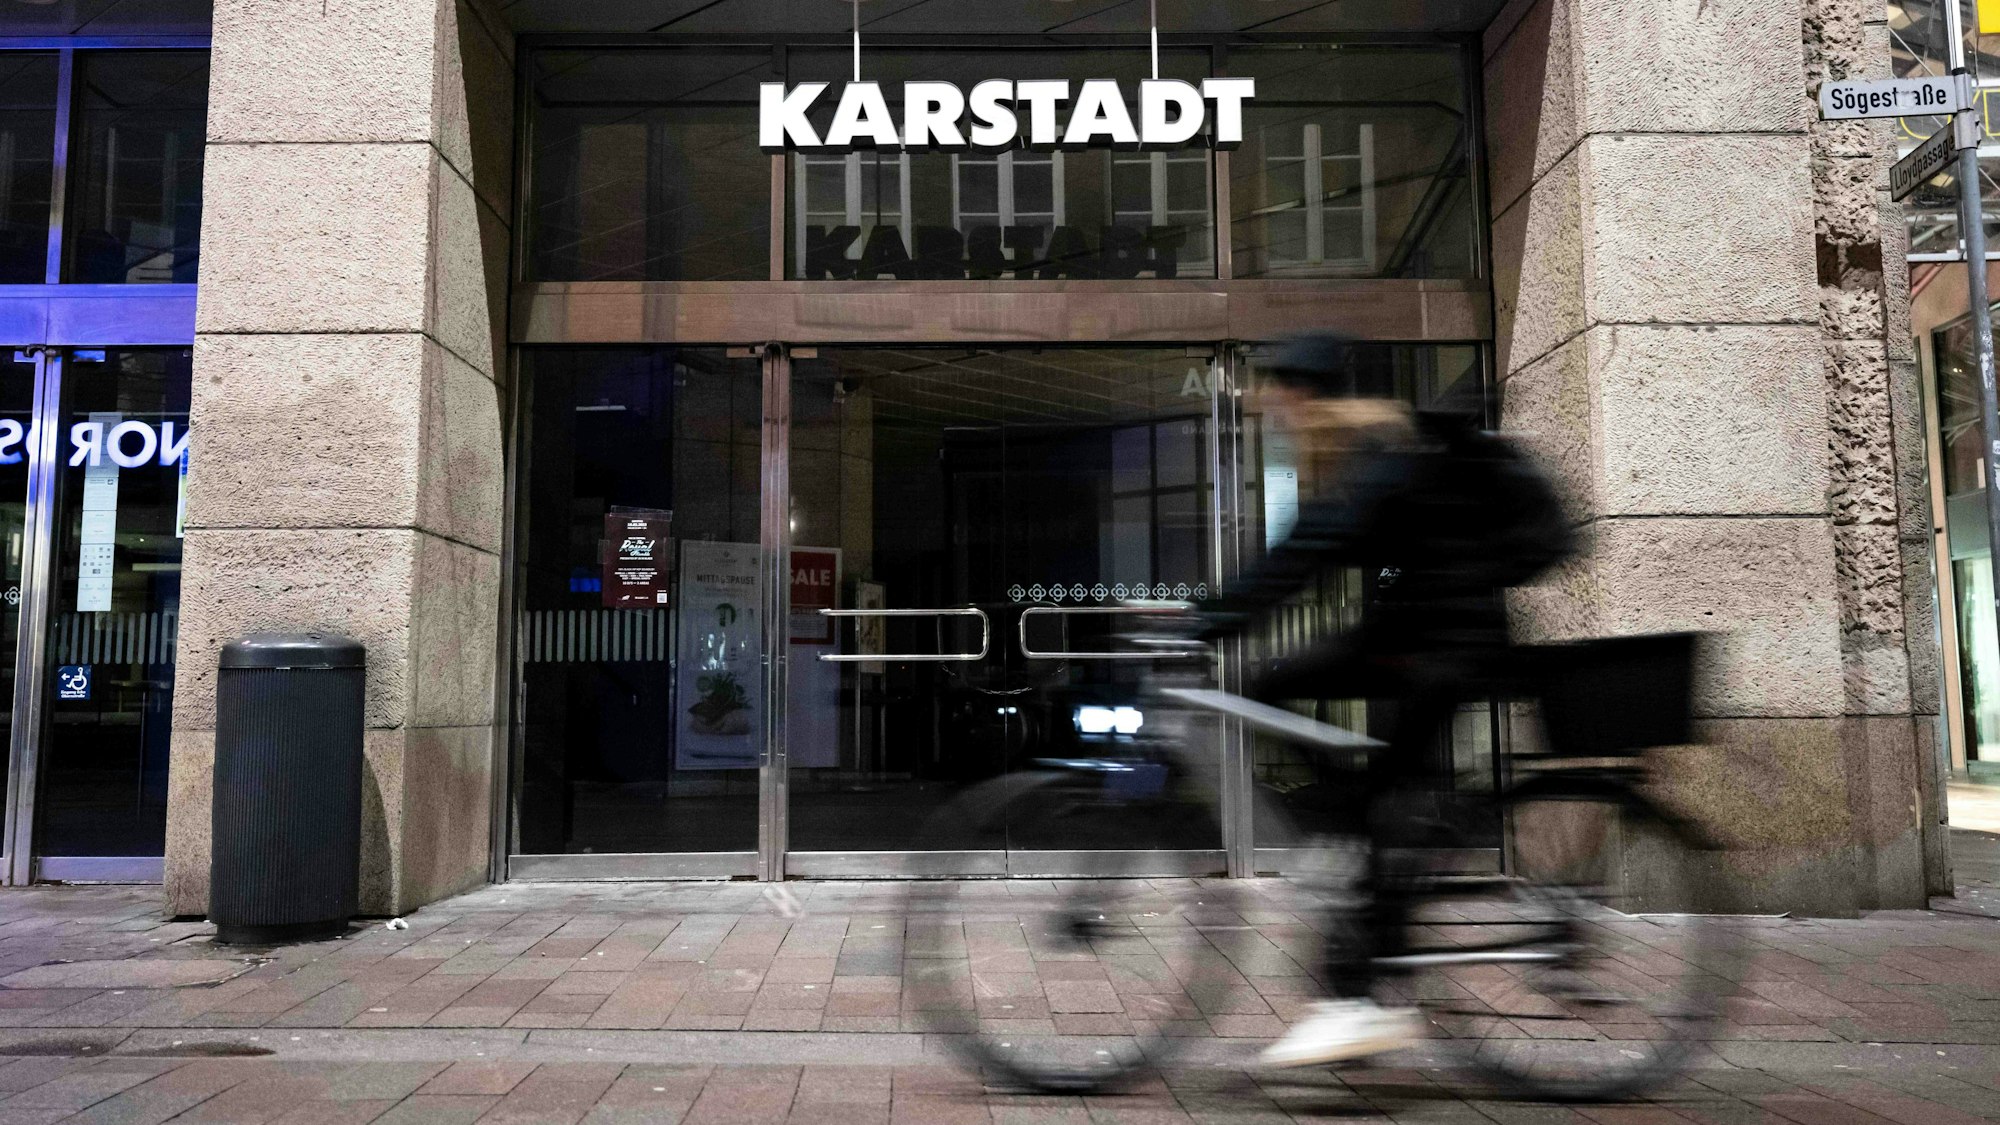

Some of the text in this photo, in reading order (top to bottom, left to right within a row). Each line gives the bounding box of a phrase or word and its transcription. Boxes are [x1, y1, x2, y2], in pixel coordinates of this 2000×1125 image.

[759, 77, 1256, 153] KARSTADT
[1893, 134, 1956, 191] Lloydpassage
[618, 540, 655, 556] Royal
[696, 573, 755, 585] MITTAGSPAUSE
